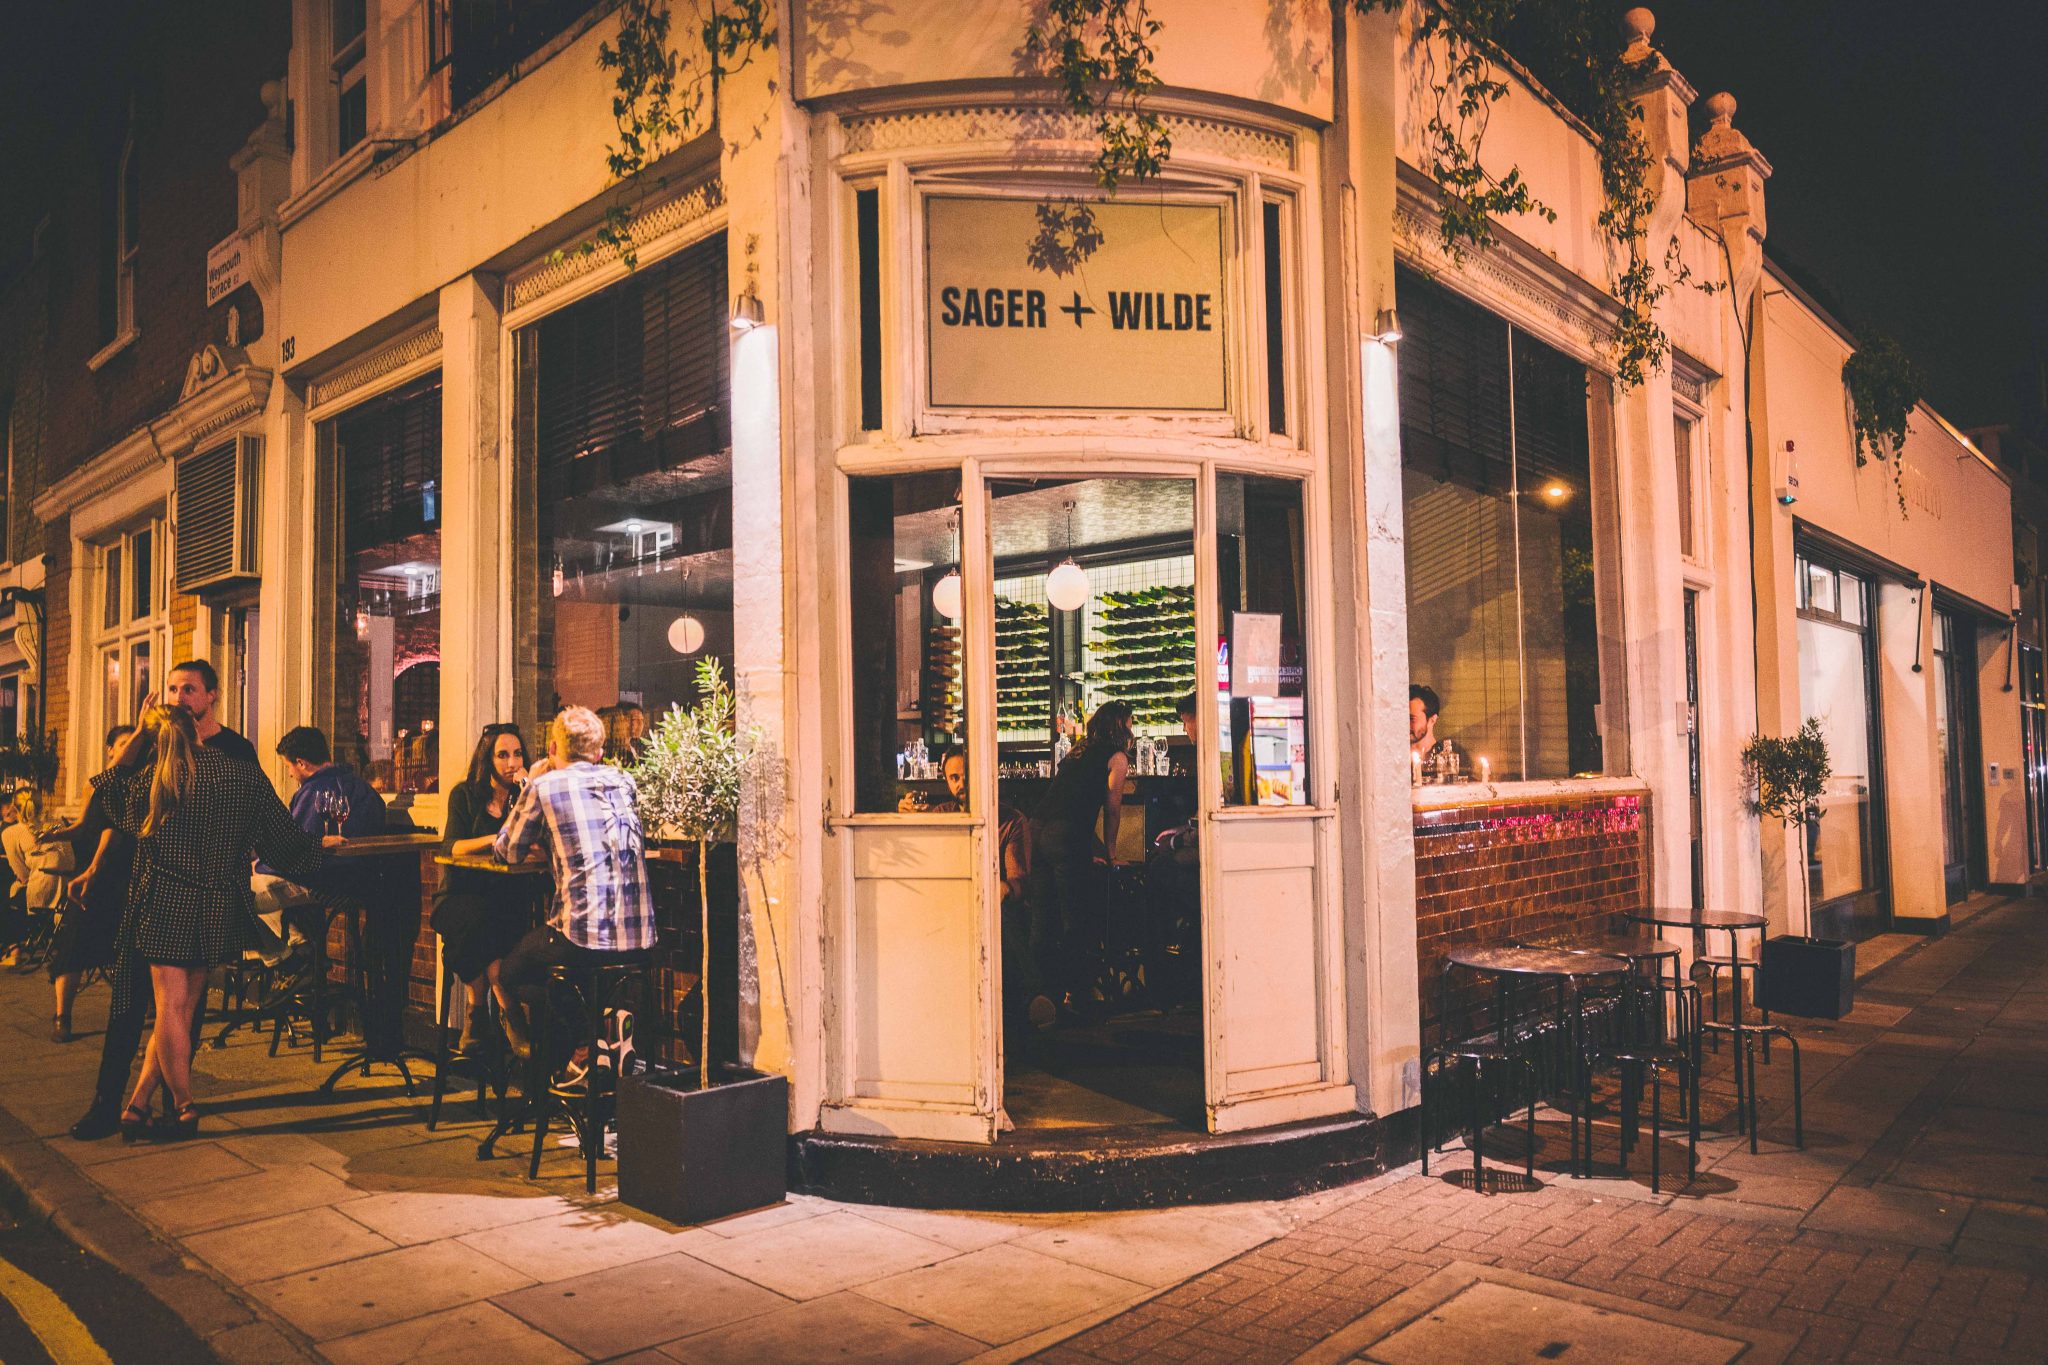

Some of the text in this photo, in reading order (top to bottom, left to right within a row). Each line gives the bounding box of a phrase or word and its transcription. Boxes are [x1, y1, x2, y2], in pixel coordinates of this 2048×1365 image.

[209, 251, 241, 283] Weymouth
[208, 272, 239, 301] Terrace E2
[941, 286, 1046, 328] SAGER
[1108, 291, 1211, 331] WILDE
[282, 336, 295, 364] 193
